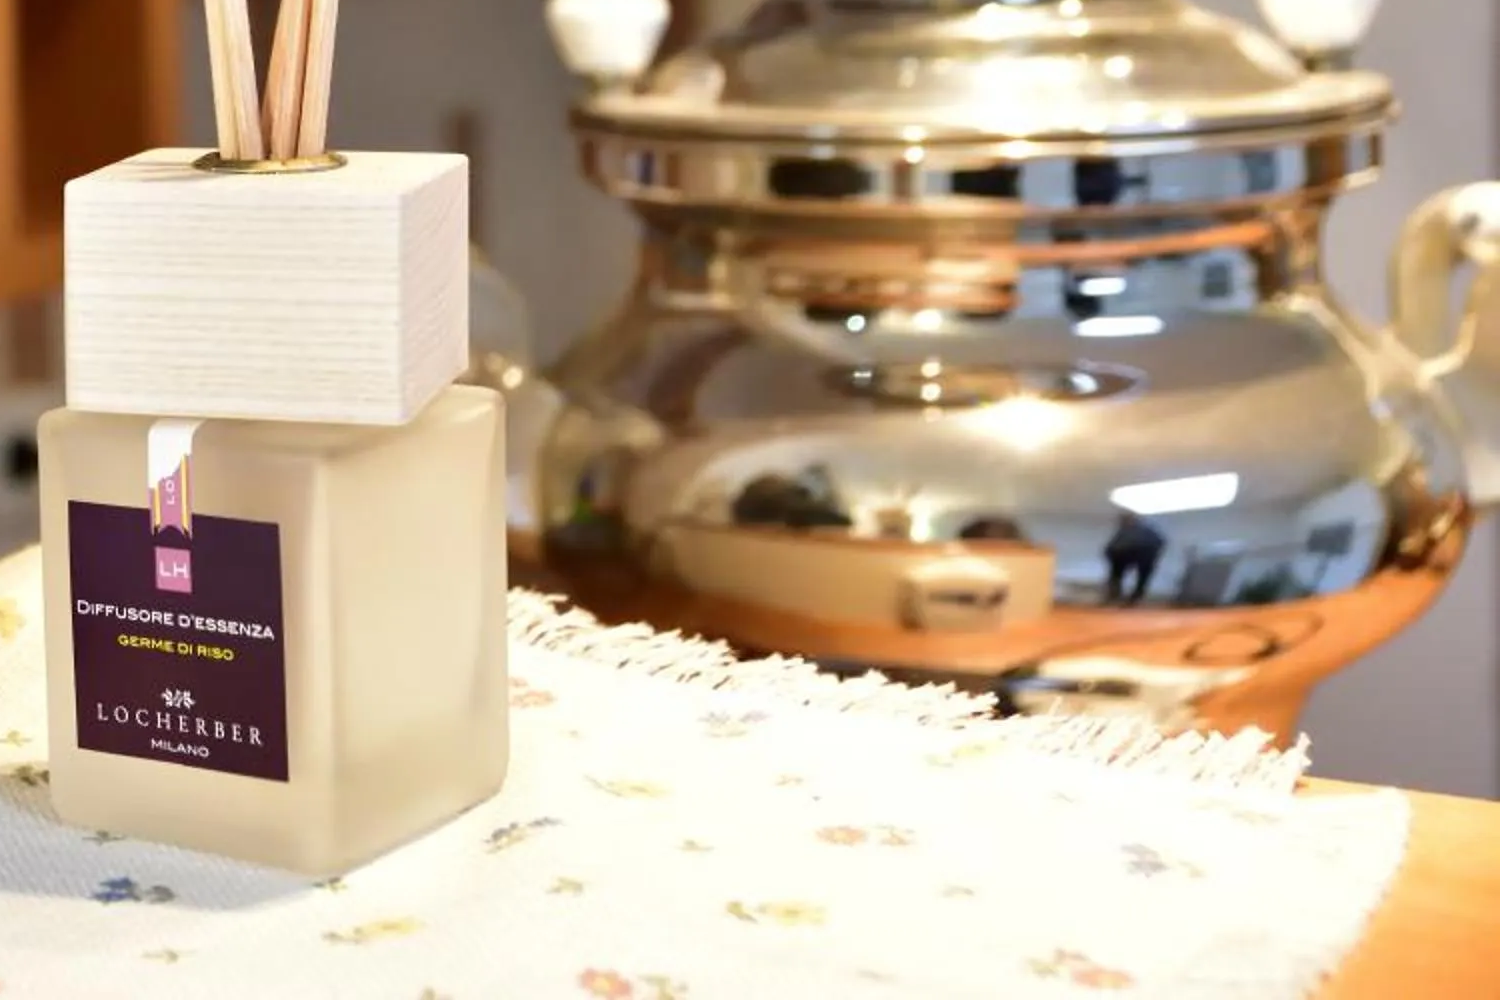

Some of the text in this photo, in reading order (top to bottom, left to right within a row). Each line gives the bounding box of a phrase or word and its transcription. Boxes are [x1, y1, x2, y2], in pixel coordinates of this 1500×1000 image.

[159, 560, 189, 579] LH
[178, 614, 275, 640] D'ESSENZA
[117, 634, 235, 661] GERME DI RISO
[96, 702, 264, 747] LOCHERBER
[150, 738, 210, 758] MILANO
